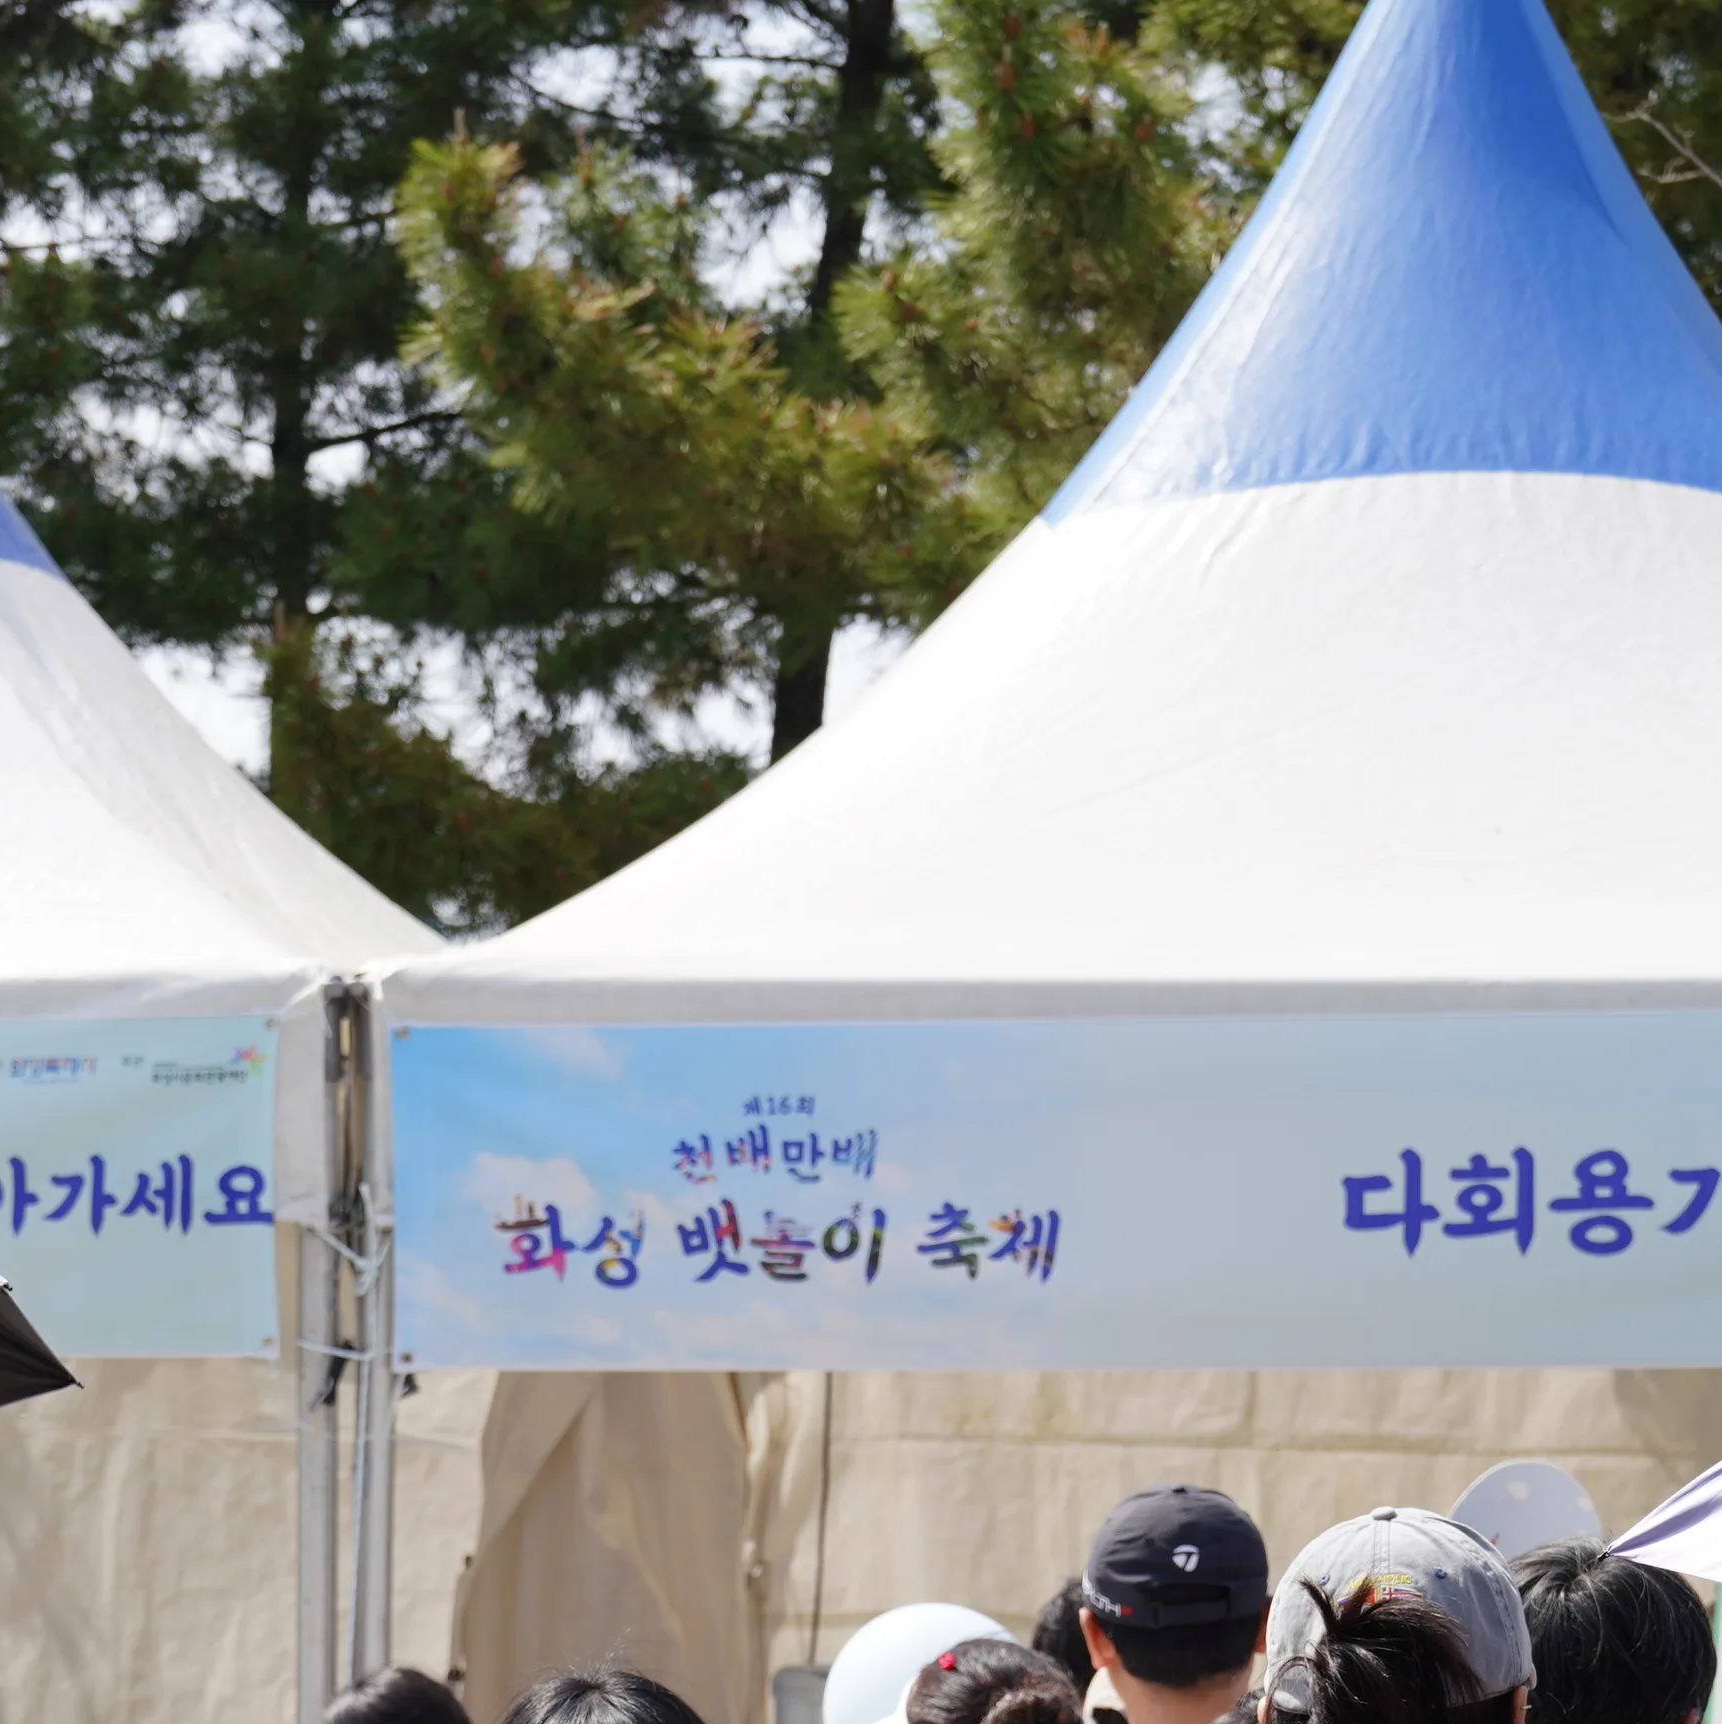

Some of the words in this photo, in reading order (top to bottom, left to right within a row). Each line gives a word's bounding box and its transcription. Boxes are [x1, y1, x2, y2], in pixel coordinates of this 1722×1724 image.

[673, 1124, 879, 1184] 천배만배
[493, 1198, 648, 1289] 화성
[677, 1199, 889, 1284] 뱃놀이
[916, 1203, 1062, 1285] 축제
